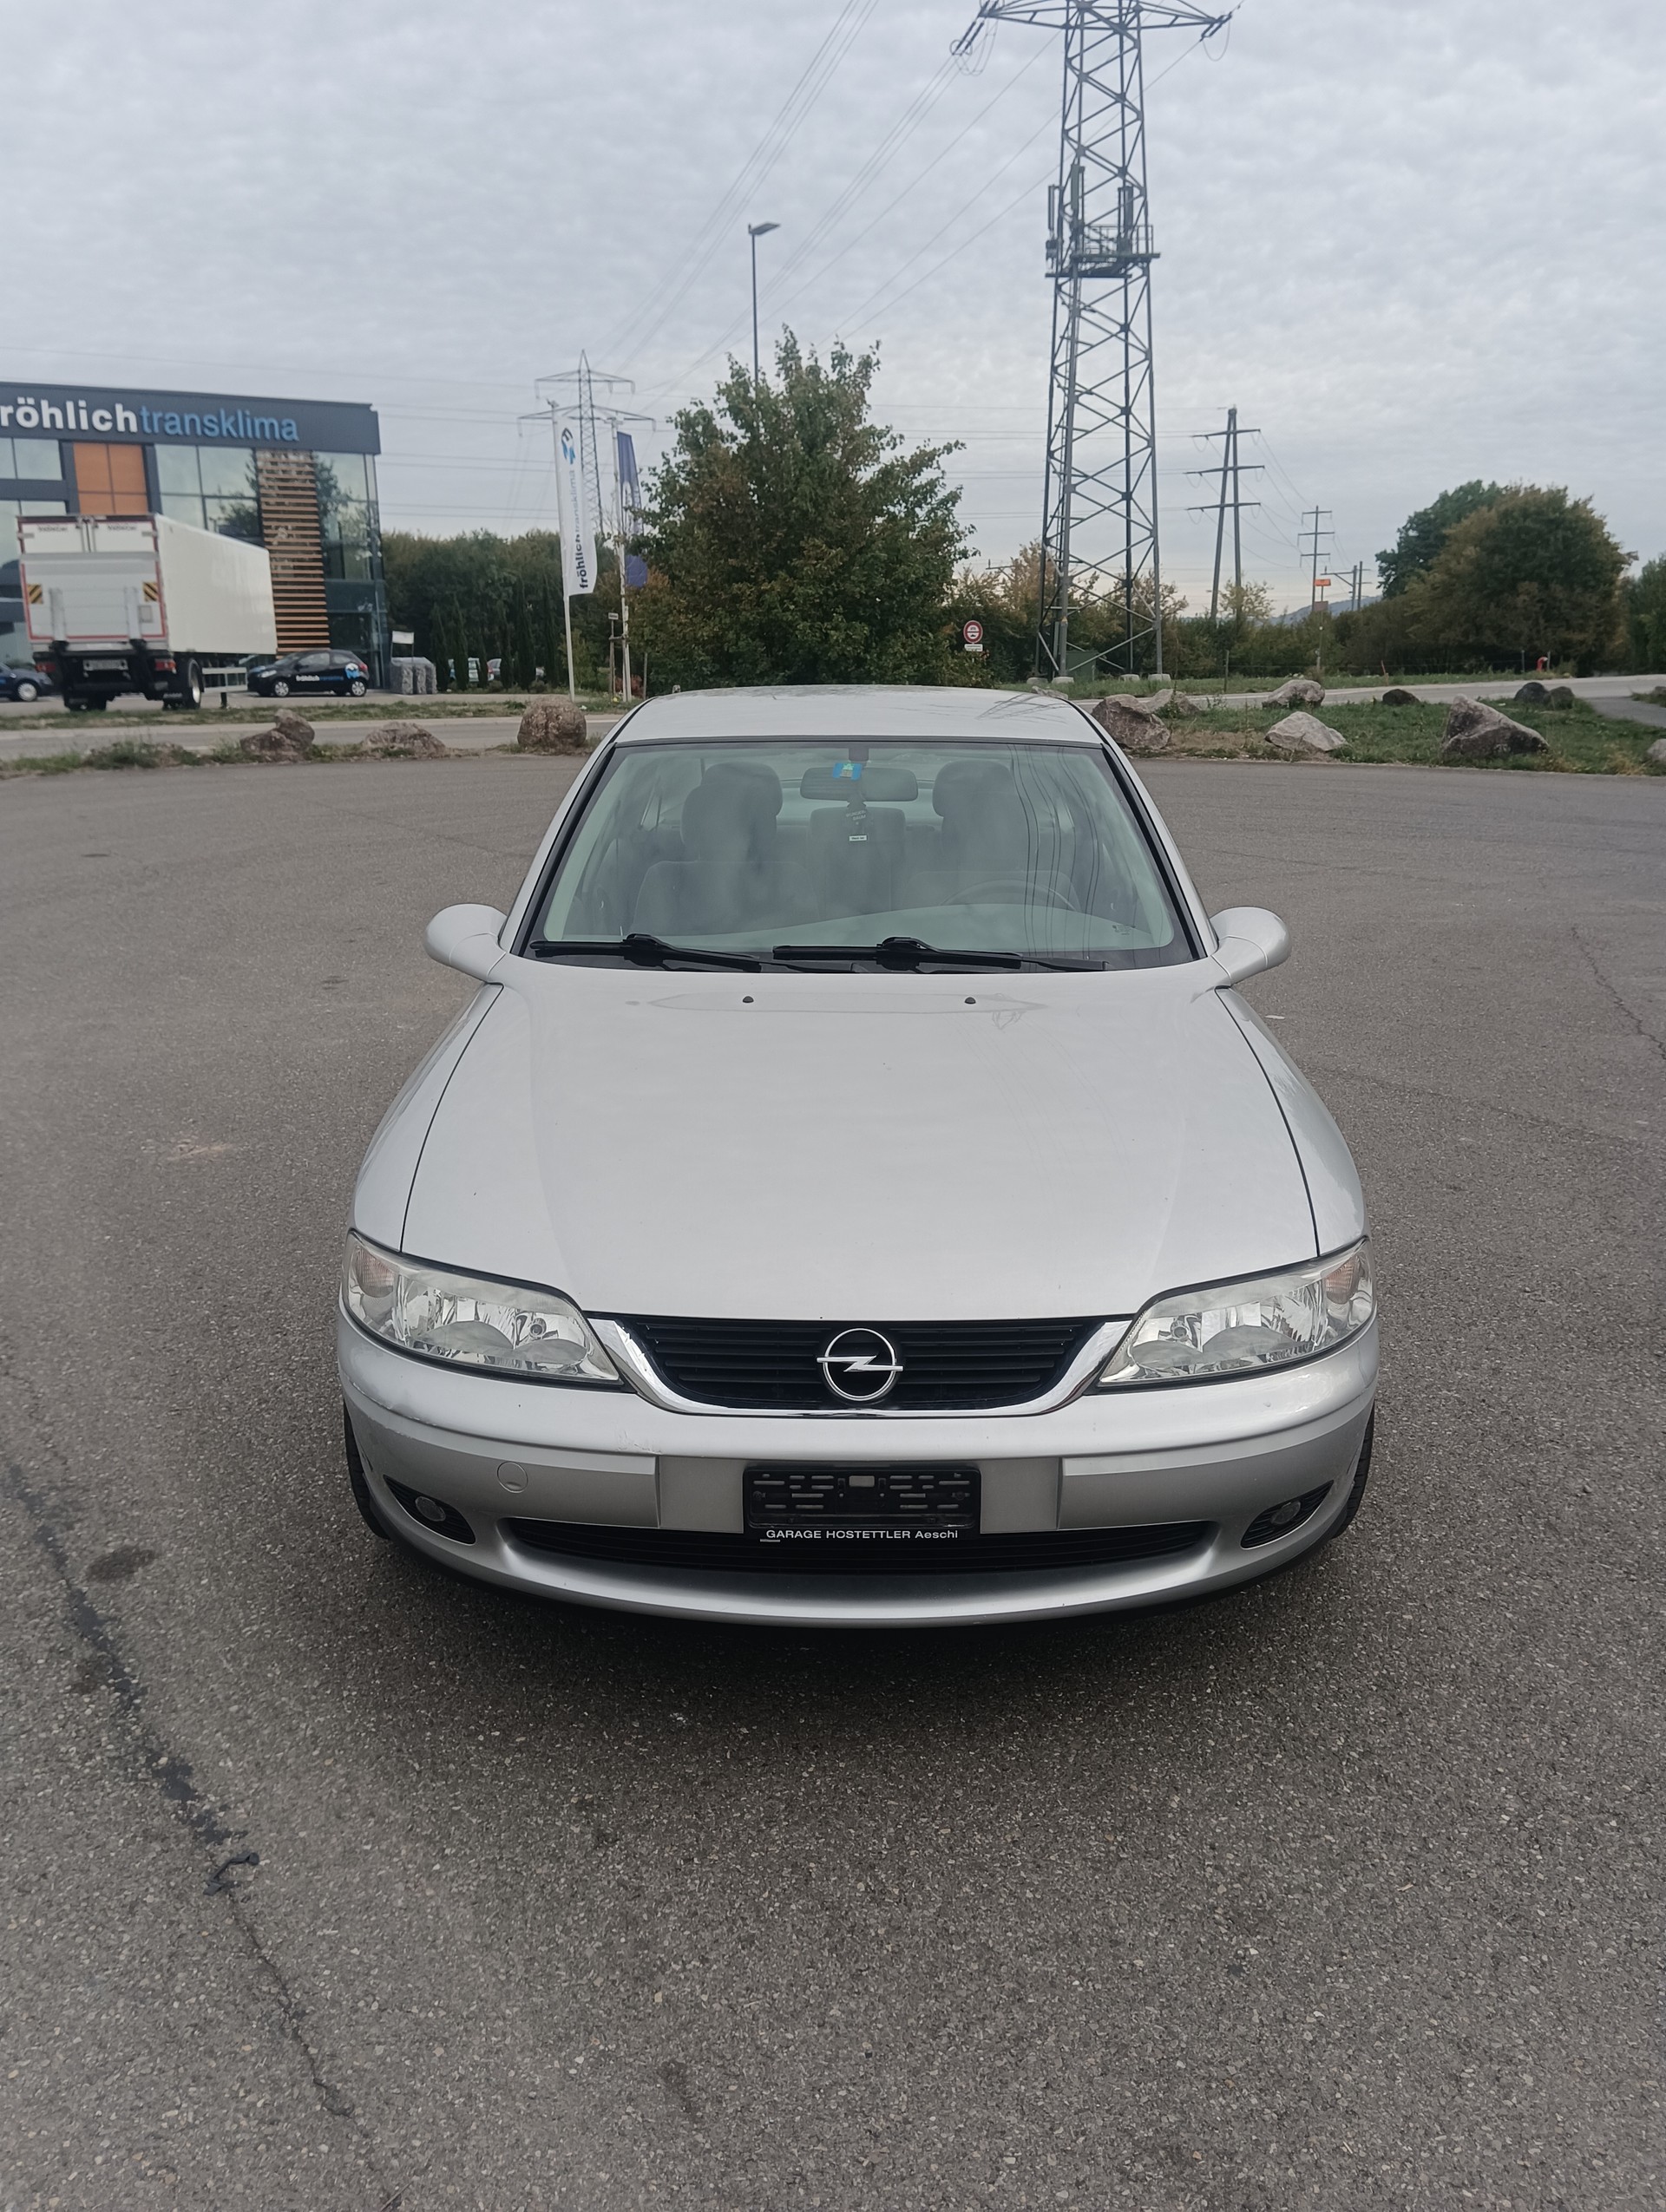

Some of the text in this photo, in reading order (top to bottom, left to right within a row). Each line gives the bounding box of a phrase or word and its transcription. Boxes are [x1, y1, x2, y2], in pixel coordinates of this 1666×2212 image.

[0, 396, 299, 442] röhlichtransklima
[766, 1529, 958, 1539] GARAGE HOSTETTLER Aeschi
